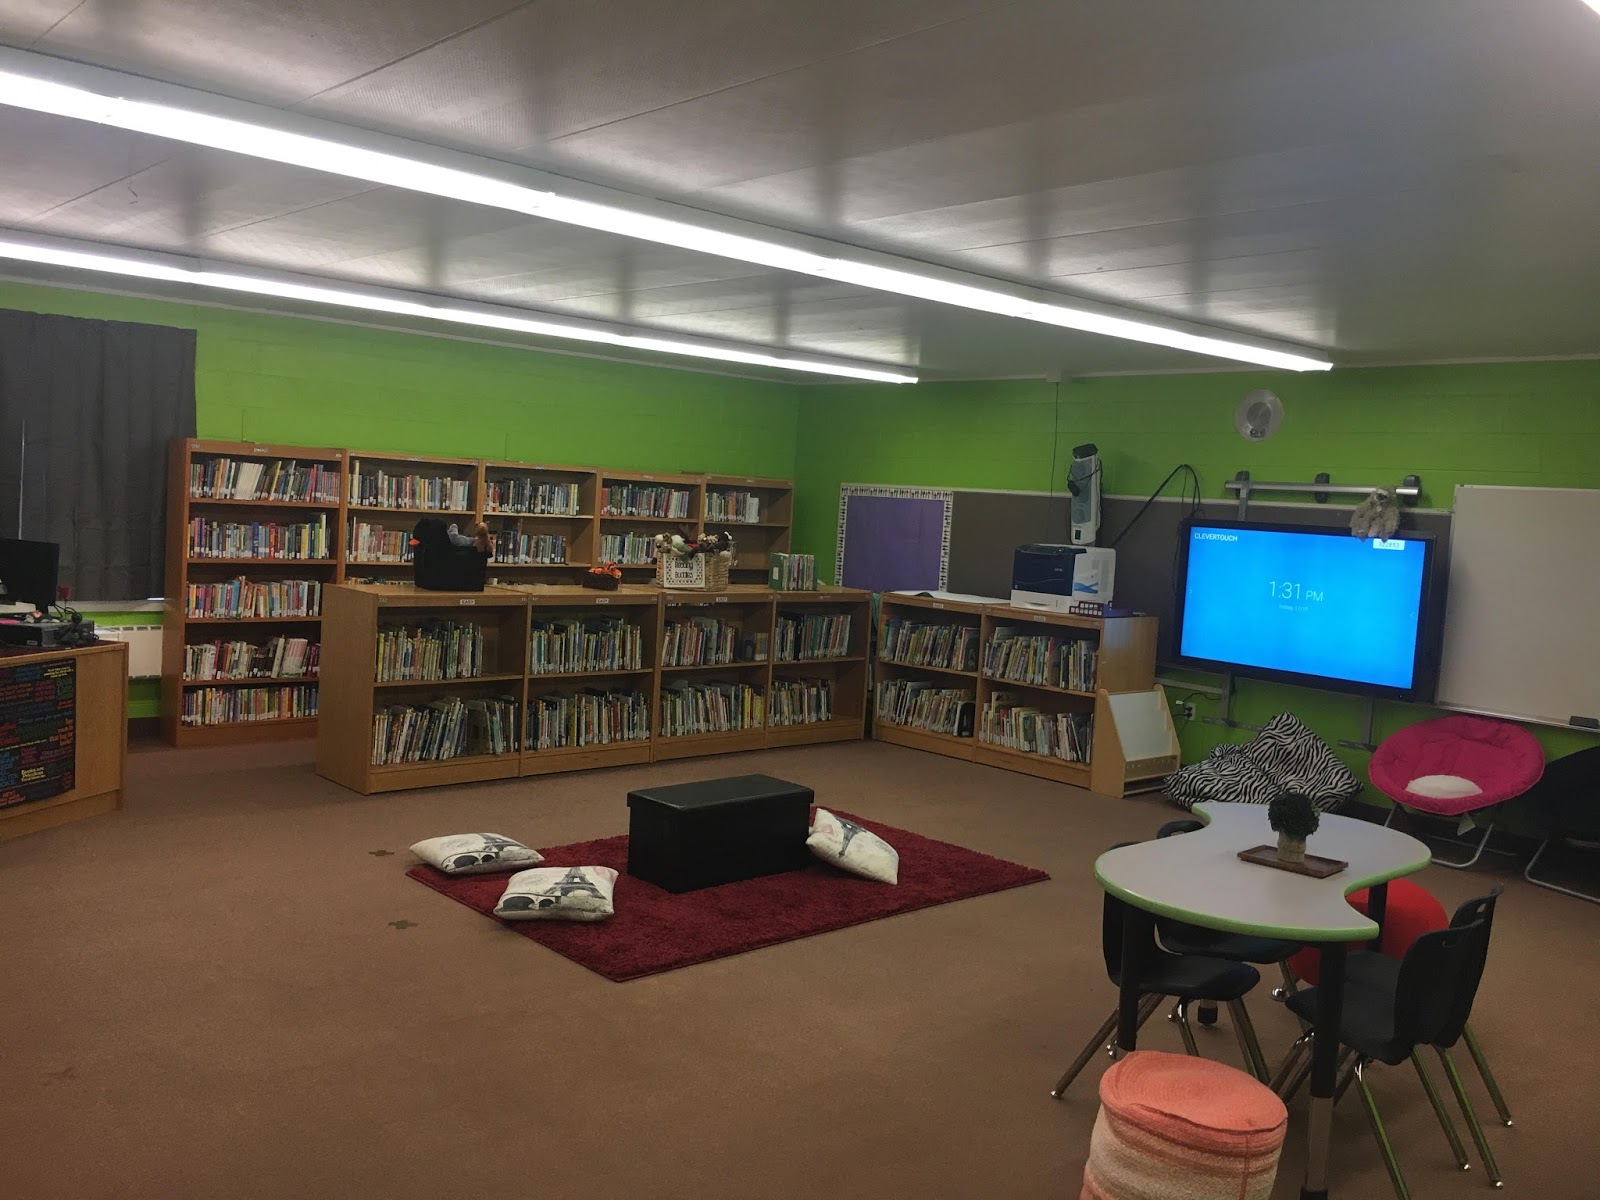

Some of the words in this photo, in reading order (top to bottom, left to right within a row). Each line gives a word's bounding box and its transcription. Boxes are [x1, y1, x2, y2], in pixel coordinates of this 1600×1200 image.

[1194, 533, 1238, 542] CLEVERTOUCH
[1269, 581, 1300, 599] 1:31
[1306, 590, 1324, 602] PM
